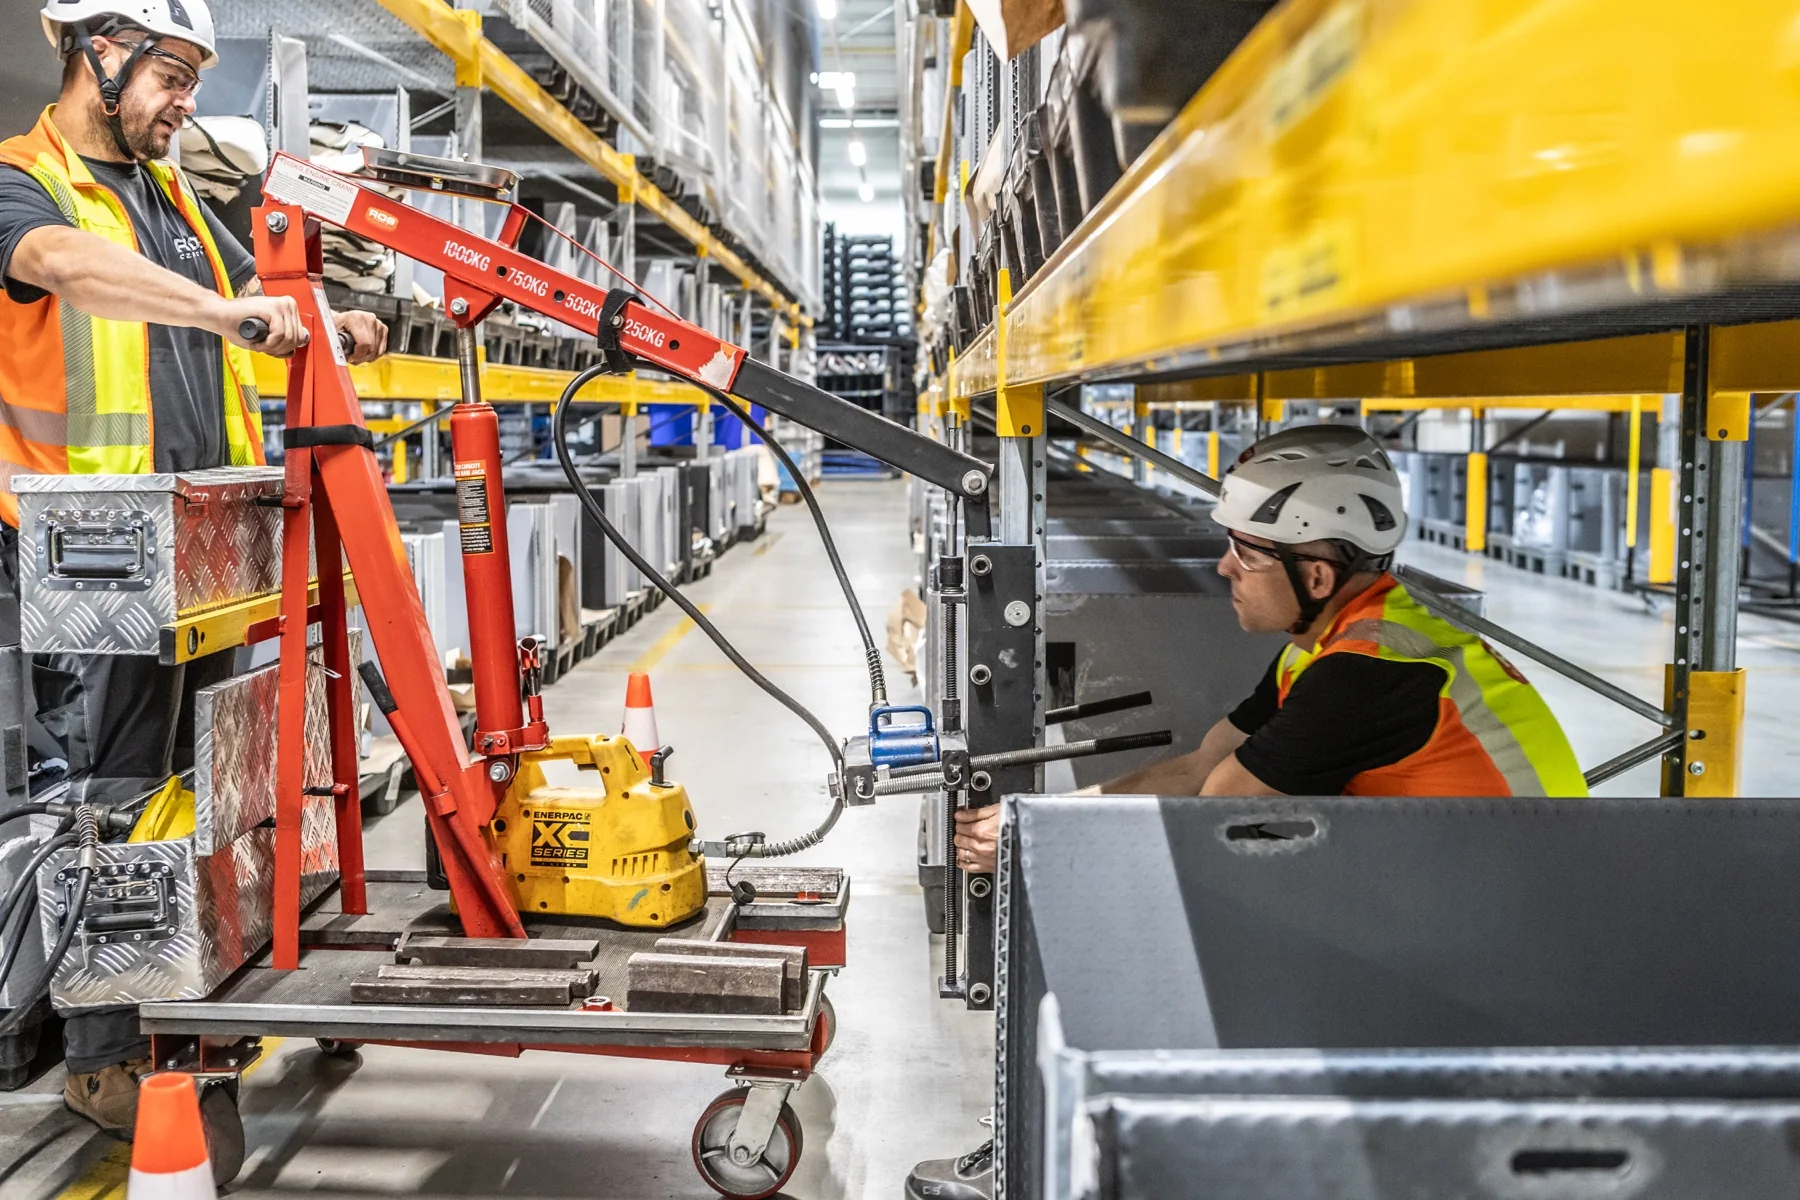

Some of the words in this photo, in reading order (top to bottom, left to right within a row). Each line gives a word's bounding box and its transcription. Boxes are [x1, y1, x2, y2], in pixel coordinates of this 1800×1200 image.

[305, 168, 331, 184] ENGINE
[332, 178, 355, 194] CRANE
[174, 236, 203, 253] RO
[443, 240, 491, 272] 1000KG
[507, 267, 549, 297] 750KG
[623, 319, 665, 348] 250KG
[533, 811, 583, 820] ENERPAC
[533, 848, 587, 858] SERIES
